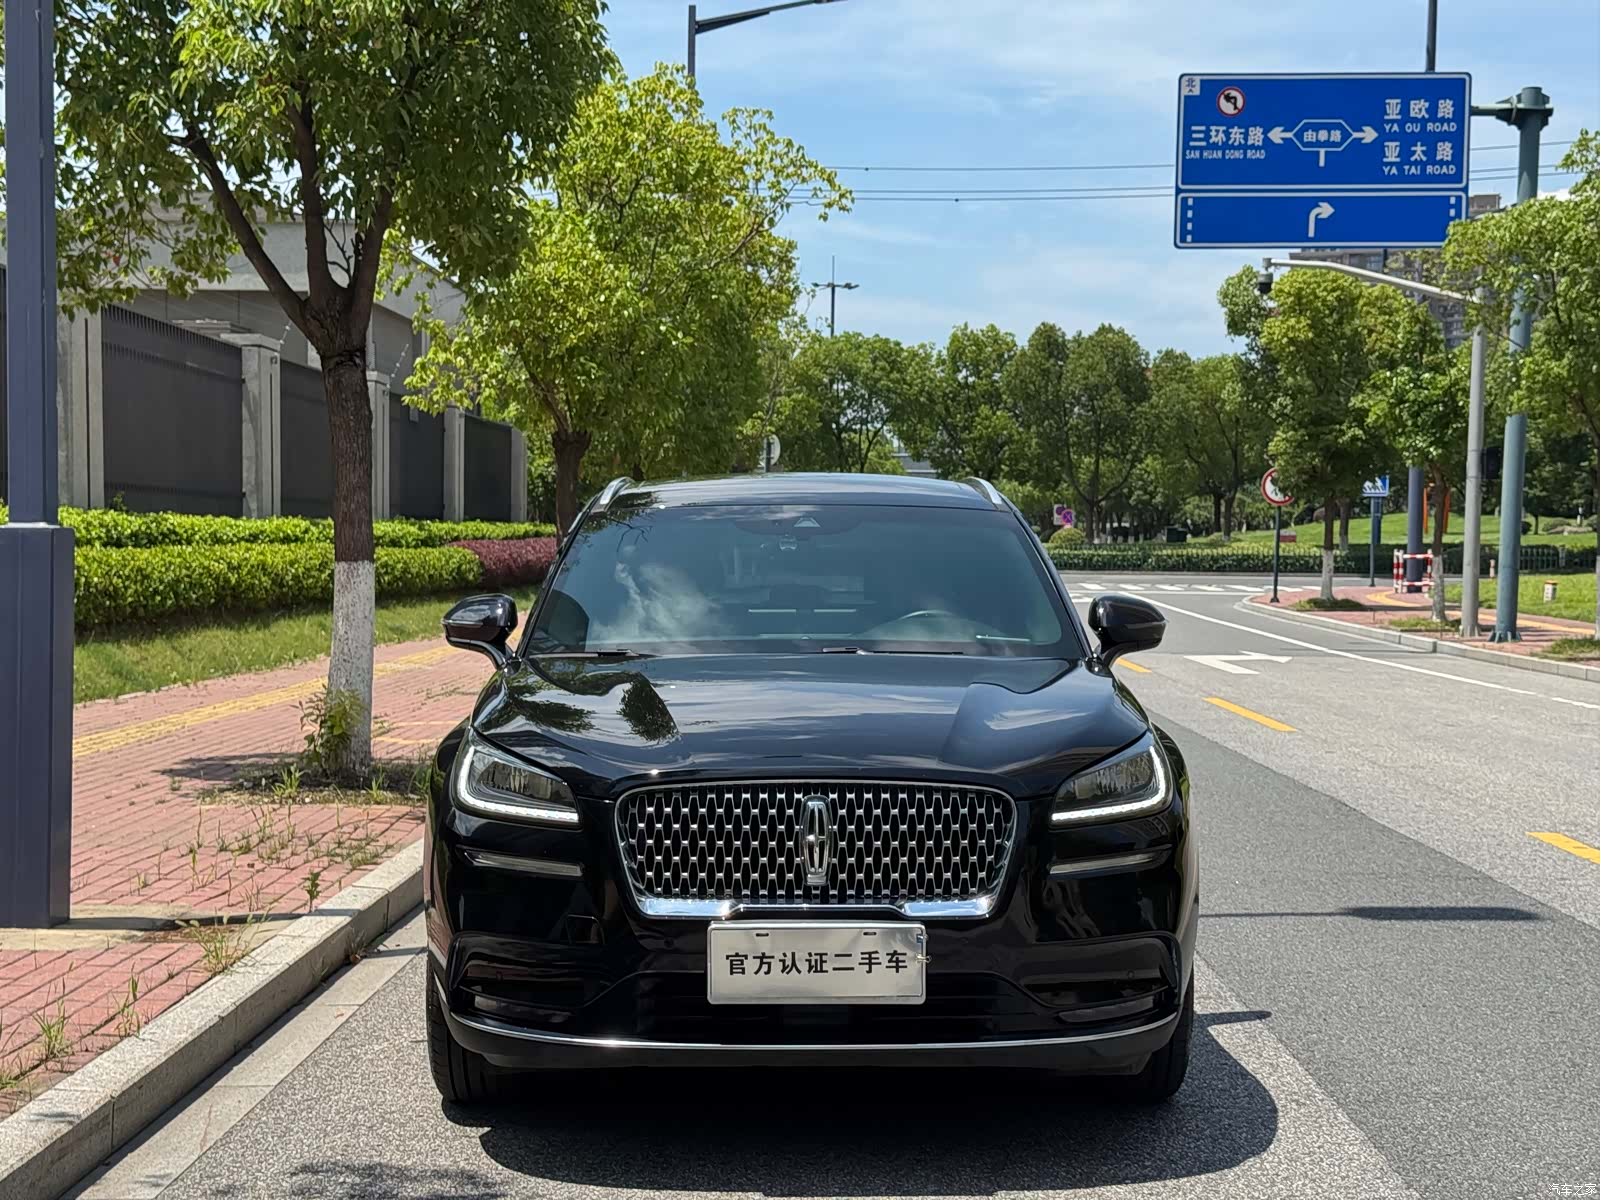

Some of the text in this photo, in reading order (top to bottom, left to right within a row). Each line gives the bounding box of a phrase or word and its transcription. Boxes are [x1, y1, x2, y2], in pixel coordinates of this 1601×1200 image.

[1185, 77, 1196, 88] 北
[1384, 98, 1455, 119] 亚欧路
[1383, 122, 1457, 133] YA OU ROAD
[1188, 125, 1265, 147] 三环东路
[1185, 149, 1266, 160] SAN HUAN DONG ROAD
[1382, 141, 1454, 162] 亚太路
[1382, 164, 1457, 176] YA TAI ROAD
[725, 950, 909, 976] 官方认证二手车
